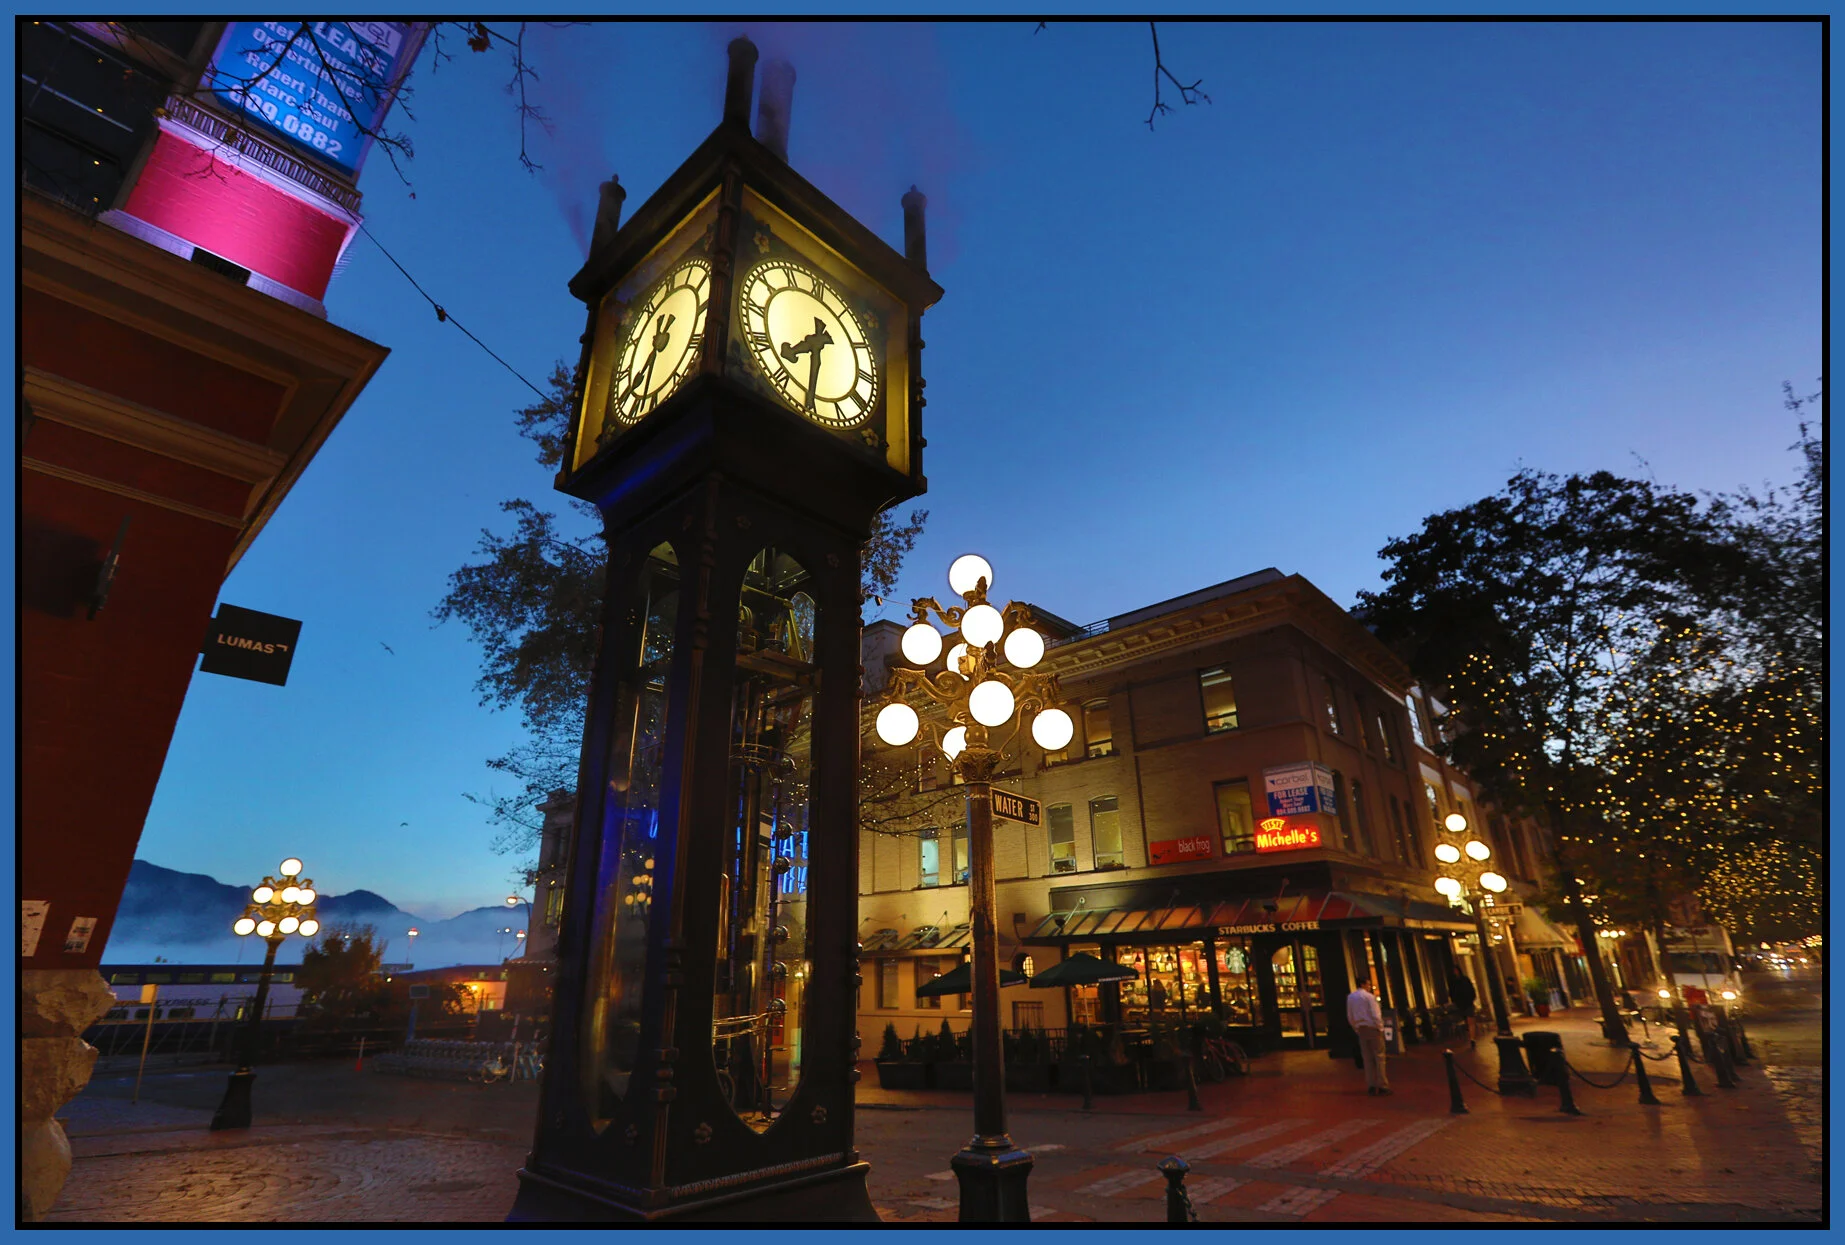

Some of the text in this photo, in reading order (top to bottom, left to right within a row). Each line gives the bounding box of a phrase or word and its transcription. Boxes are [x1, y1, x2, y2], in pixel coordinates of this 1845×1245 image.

[314, 22, 388, 77] LEASE
[245, 51, 306, 94] Robert
[217, 633, 275, 655] LUMAS
[1273, 786, 1309, 800] FOR LEASE
[994, 794, 1024, 818] WATER
[1261, 819, 1284, 831] VISIT
[1178, 836, 1210, 854] black frog
[1257, 828, 1318, 849] Michelle's
[1218, 921, 1320, 935] STARBUCKS COFFEE
